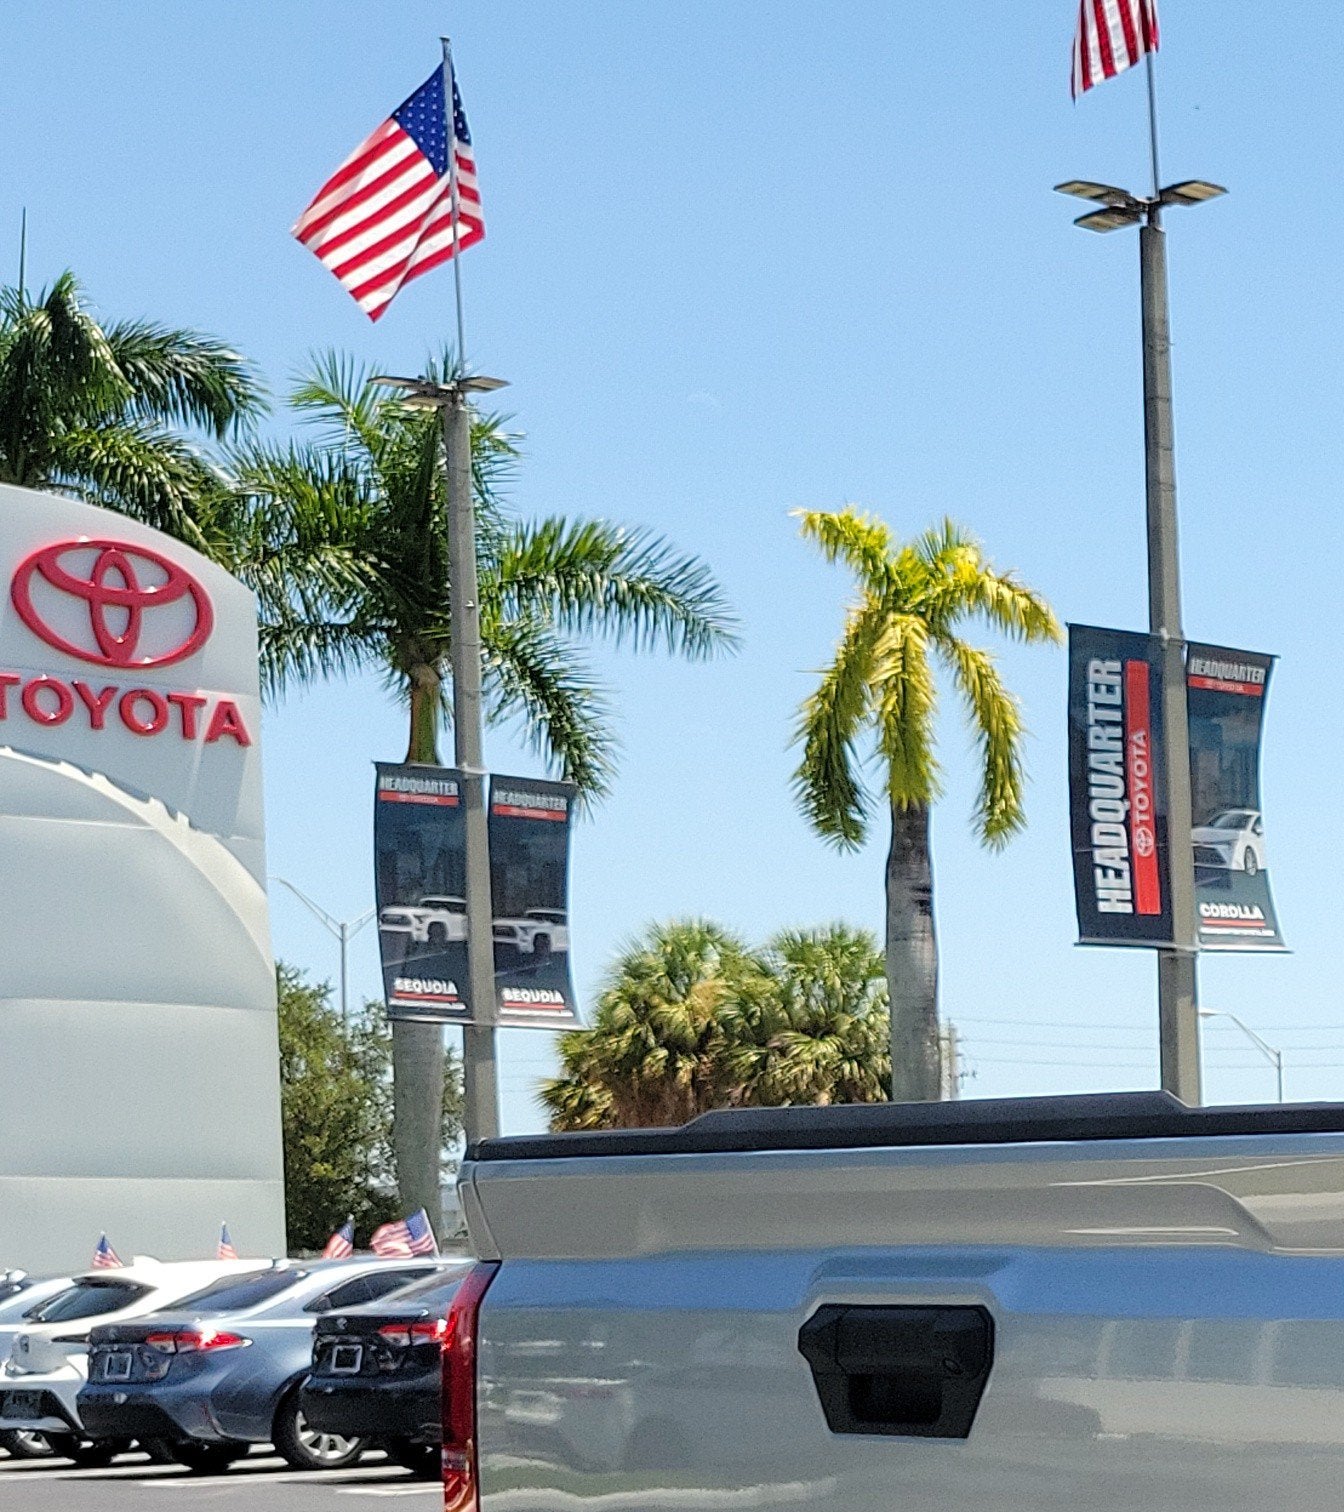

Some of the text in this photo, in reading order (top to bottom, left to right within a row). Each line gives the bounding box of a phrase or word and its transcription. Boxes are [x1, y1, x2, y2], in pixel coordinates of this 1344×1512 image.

[0, 673, 252, 747] TOYOTA
[1087, 658, 1134, 914] HEADQUARTER
[1130, 731, 1154, 823] TOYOTA
[1199, 902, 1266, 919] COROLLA
[393, 977, 459, 995] SEQUOIA
[502, 987, 565, 1004] SEQUOIA
